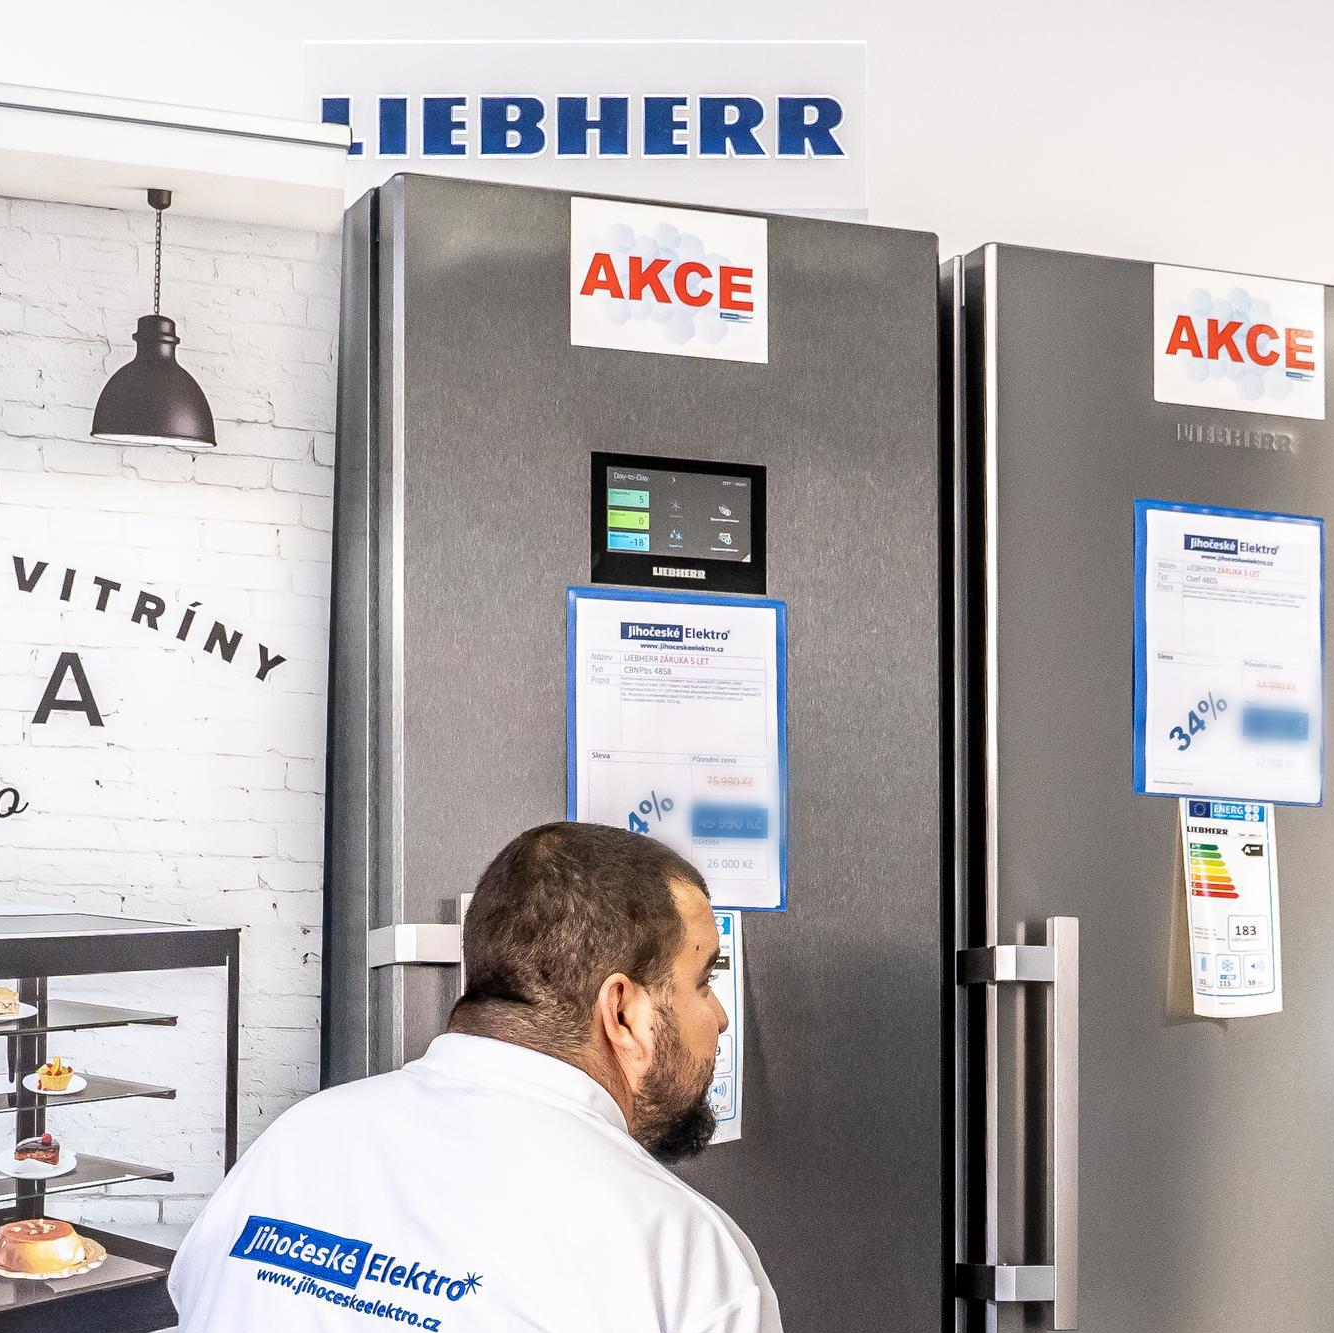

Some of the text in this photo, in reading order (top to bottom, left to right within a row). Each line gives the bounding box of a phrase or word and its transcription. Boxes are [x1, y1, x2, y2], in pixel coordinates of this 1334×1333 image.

[580, 252, 753, 312] AKCE
[1165, 315, 1315, 371] AKCE
[1239, 541, 1277, 556] Elektro
[653, 566, 706, 579] LIEBHERR
[13, 553, 288, 682] VITRÍNY
[628, 624, 728, 641] Jihočeské Elektro
[640, 641, 724, 653] www.jihoceskeelektro.cz
[624, 654, 658, 663] LIEBHERR
[659, 654, 689, 664] ZÁRUKA
[697, 657, 709, 665] LET
[1169, 691, 1227, 751] 34%
[1214, 804, 1243, 815] ENERG
[1187, 825, 1228, 835] LIEBHERR
[707, 859, 719, 868] 26
[722, 859, 740, 869] 000
[1235, 925, 1257, 936] 183
[244, 1225, 466, 1302] Jihočeské Elektro
[257, 1267, 442, 1333] www.jihoceskeelektro.cz
